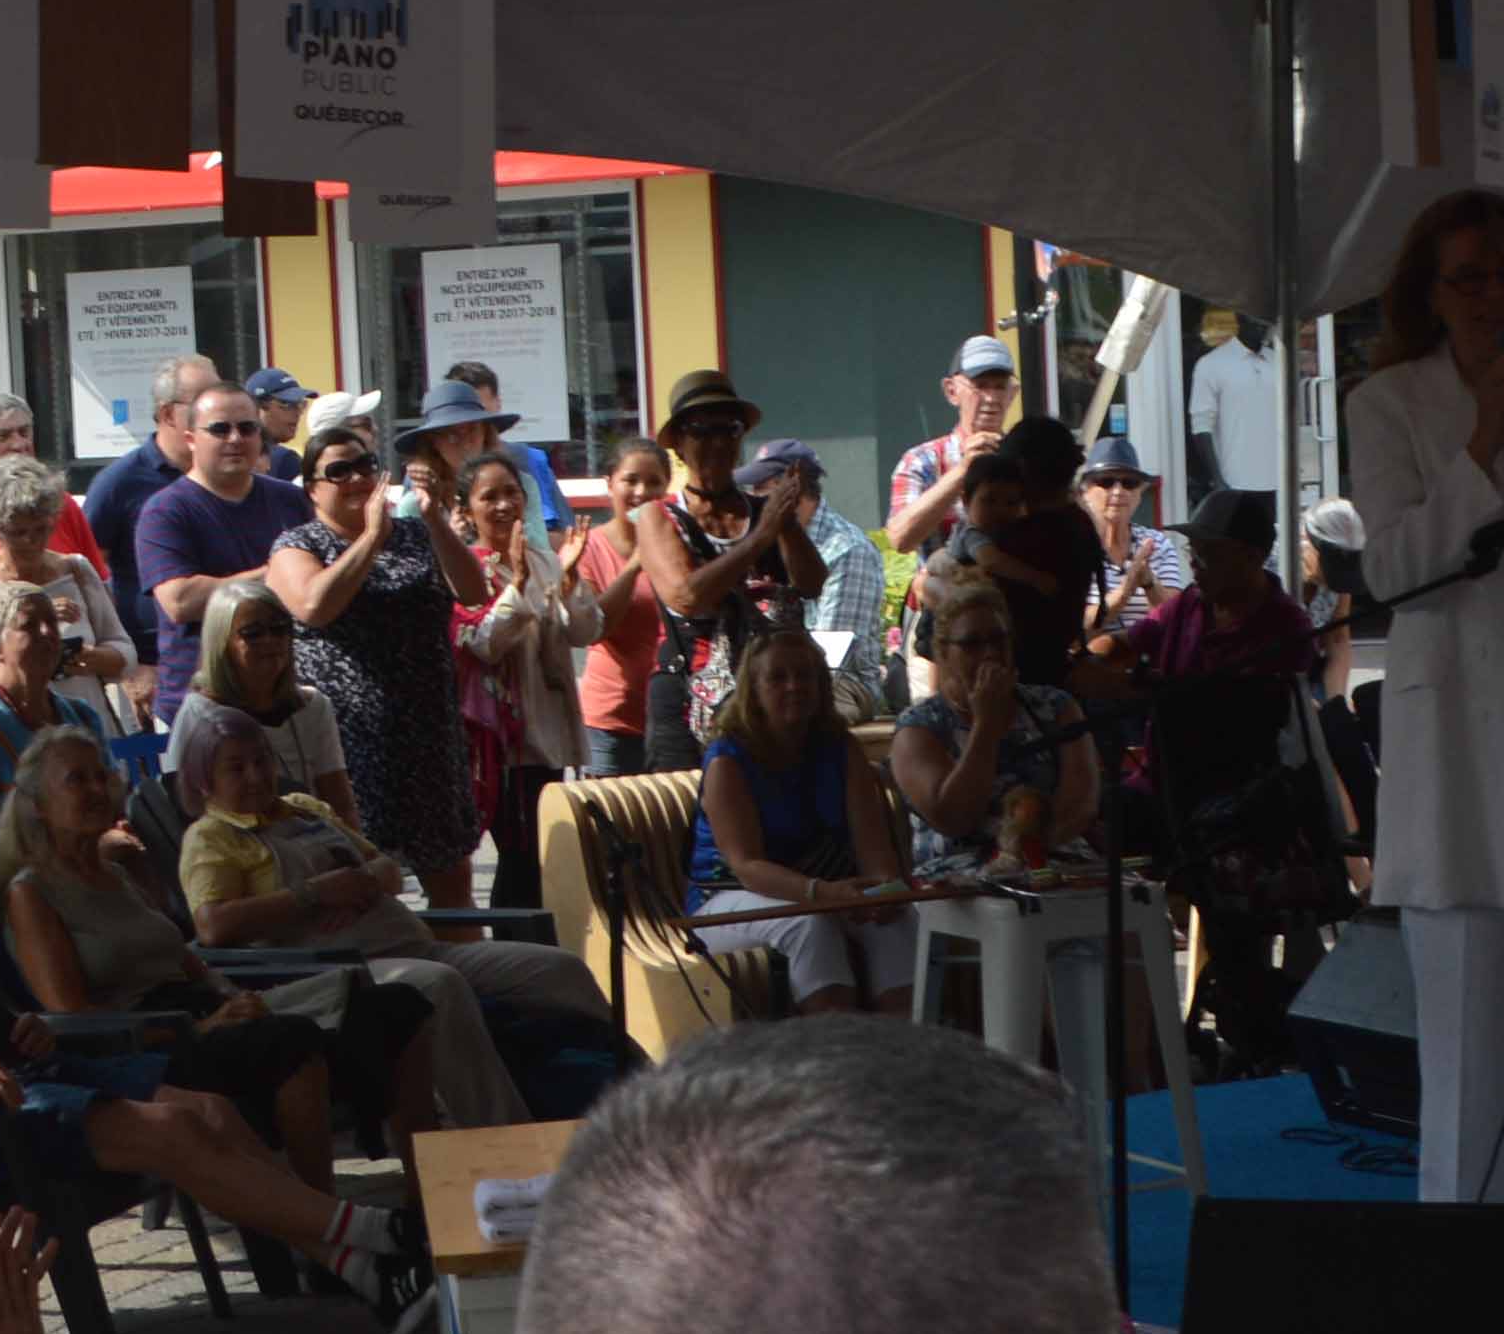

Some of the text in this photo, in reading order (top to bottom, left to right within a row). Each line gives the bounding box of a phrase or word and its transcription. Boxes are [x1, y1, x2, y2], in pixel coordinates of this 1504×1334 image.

[303, 31, 397, 69] PIANO
[302, 69, 396, 96] PUBLIC
[295, 103, 405, 125] QUÉBECOR
[456, 266, 528, 281] ENTREZ VOIR
[97, 290, 135, 301] ENTREZ
[440, 284, 464, 295] NOS
